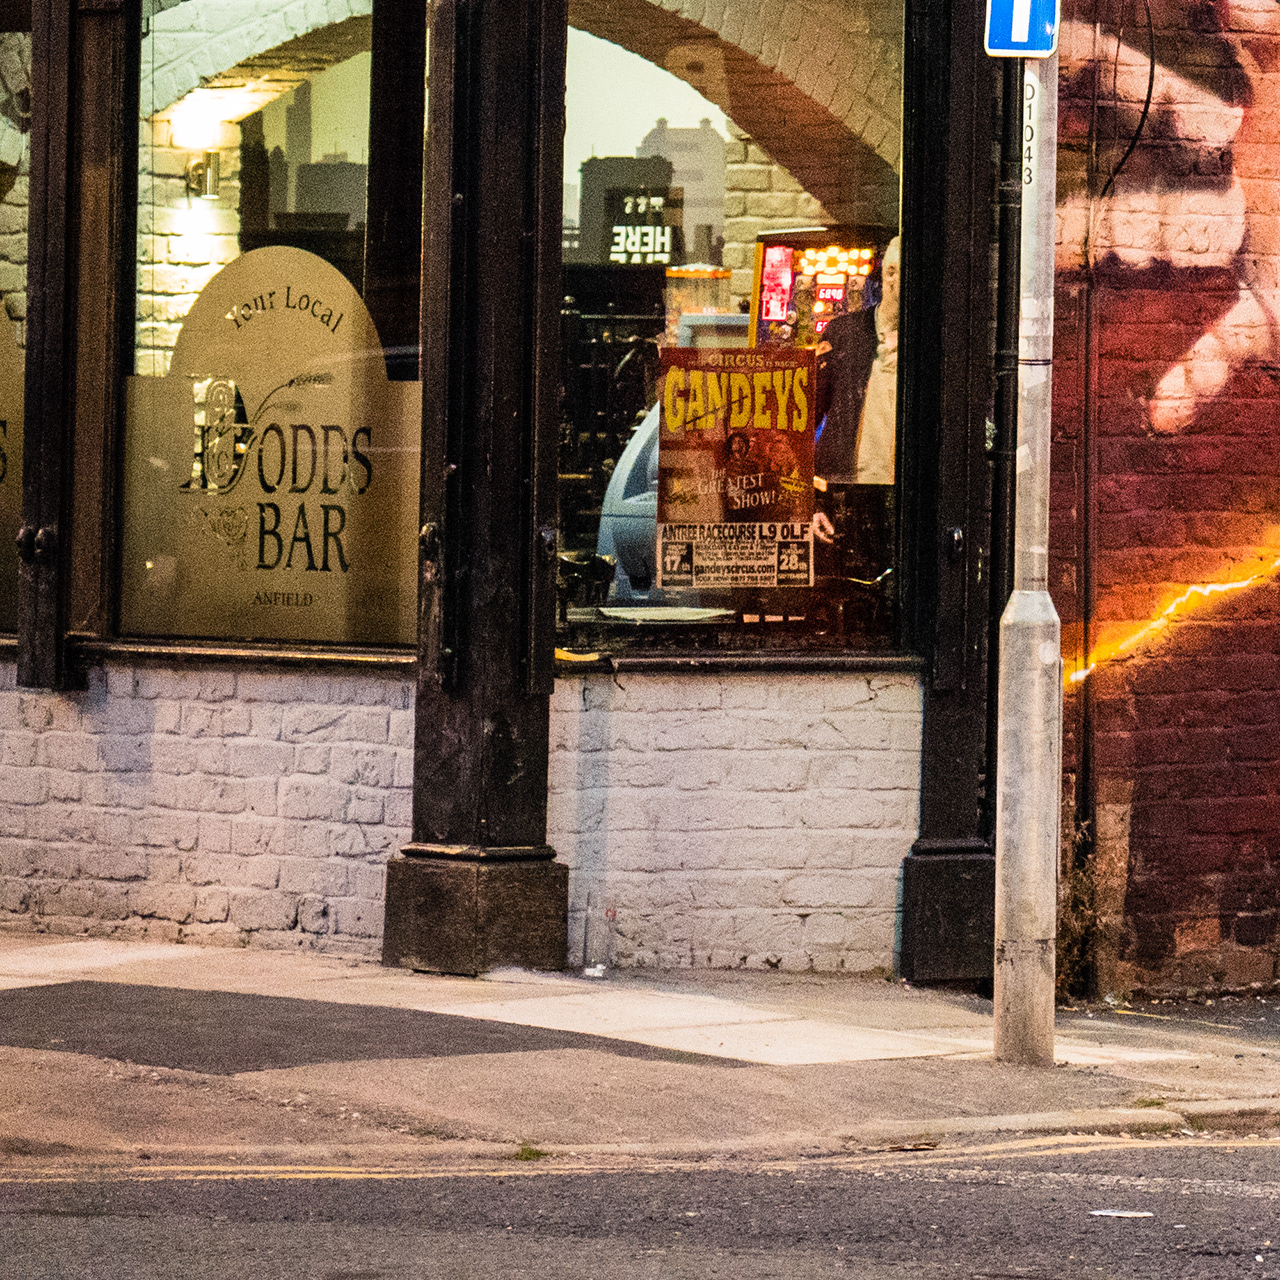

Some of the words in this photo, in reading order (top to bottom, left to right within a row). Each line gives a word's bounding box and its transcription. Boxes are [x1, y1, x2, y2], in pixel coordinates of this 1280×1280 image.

[225, 289, 276, 329] Your
[285, 286, 344, 334] Local
[707, 353, 764, 367] CIRCUS
[664, 365, 809, 433] GANDEYS
[178, 377, 373, 496] DODDS
[696, 473, 764, 495] GREATEST
[257, 502, 350, 572] BAR
[662, 524, 697, 540] AINTREE
[699, 524, 756, 540] RACECOURSE
[759, 524, 777, 540] L9
[694, 563, 775, 576] gandeyscircus.com
[252, 590, 313, 607] ANFIELD
